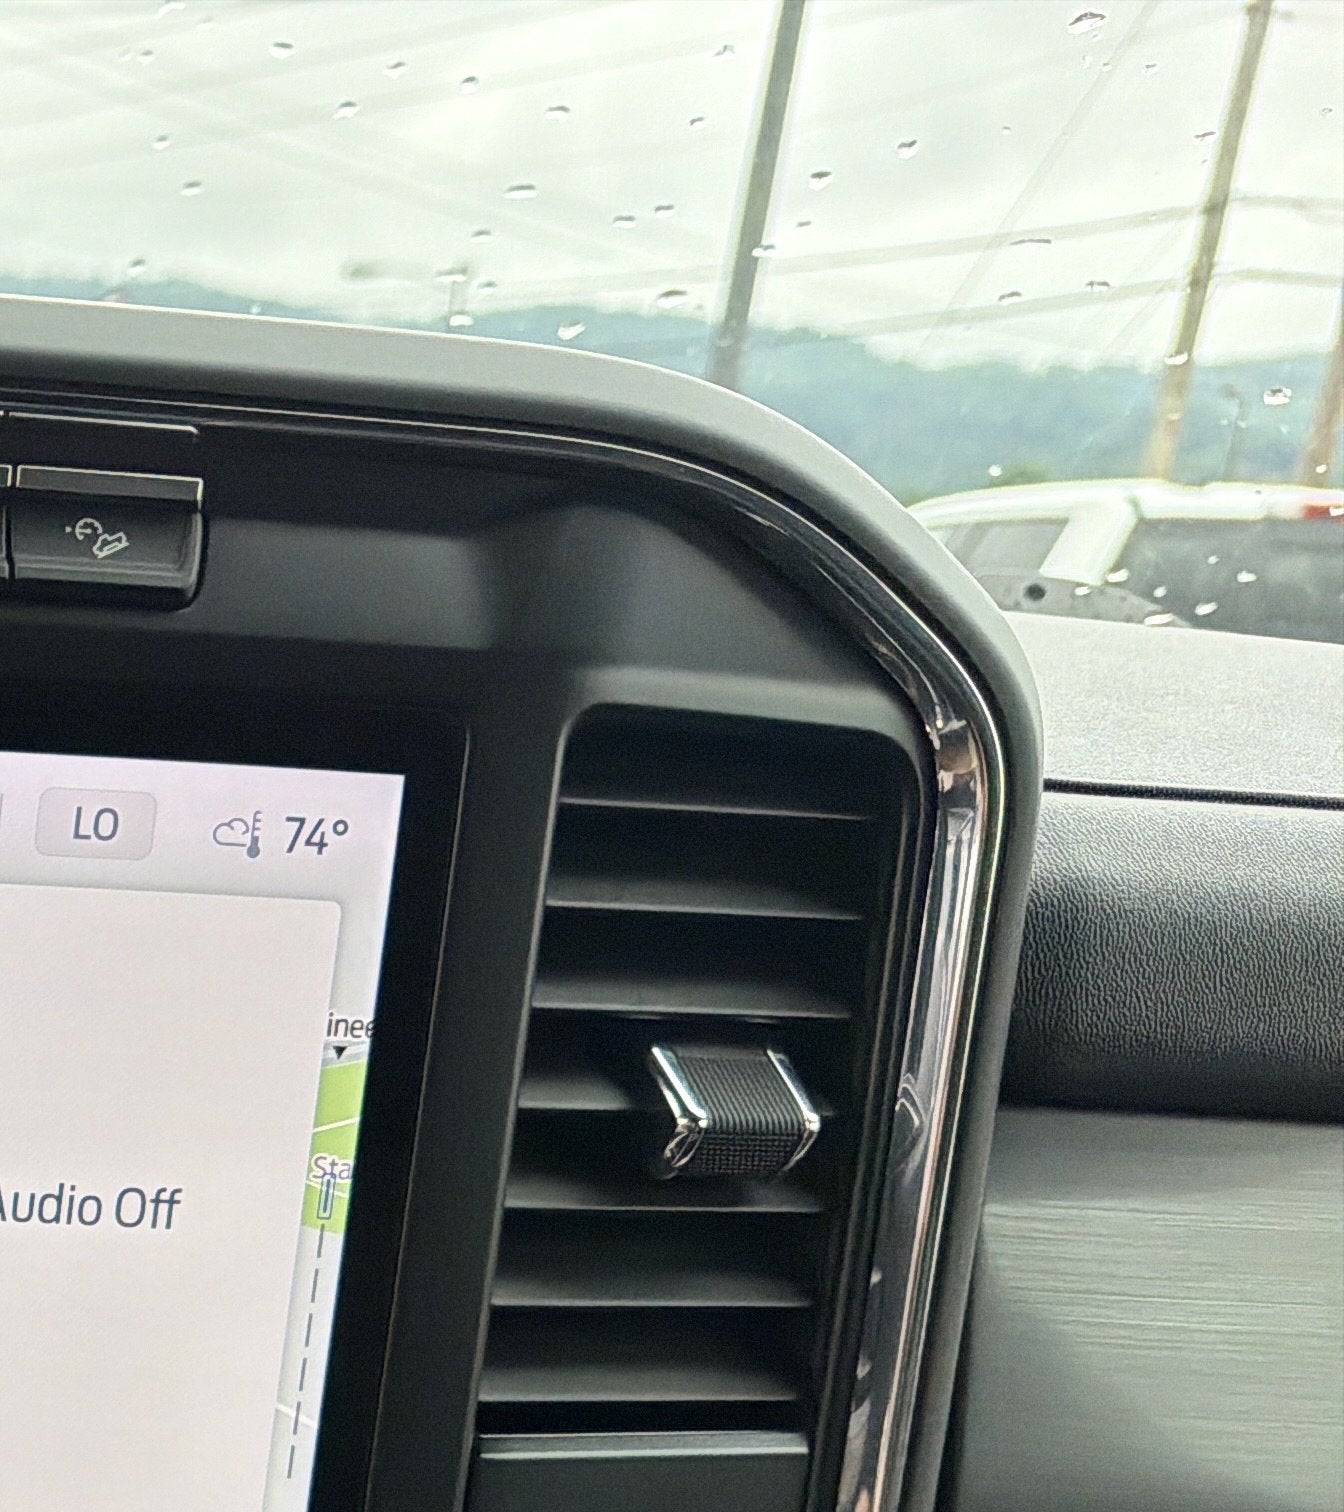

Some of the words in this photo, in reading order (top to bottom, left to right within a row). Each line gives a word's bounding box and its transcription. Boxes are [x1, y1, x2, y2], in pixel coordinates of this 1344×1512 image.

[73, 807, 119, 841] LO
[284, 816, 349, 856] 74°
[114, 1186, 183, 1231] Off
